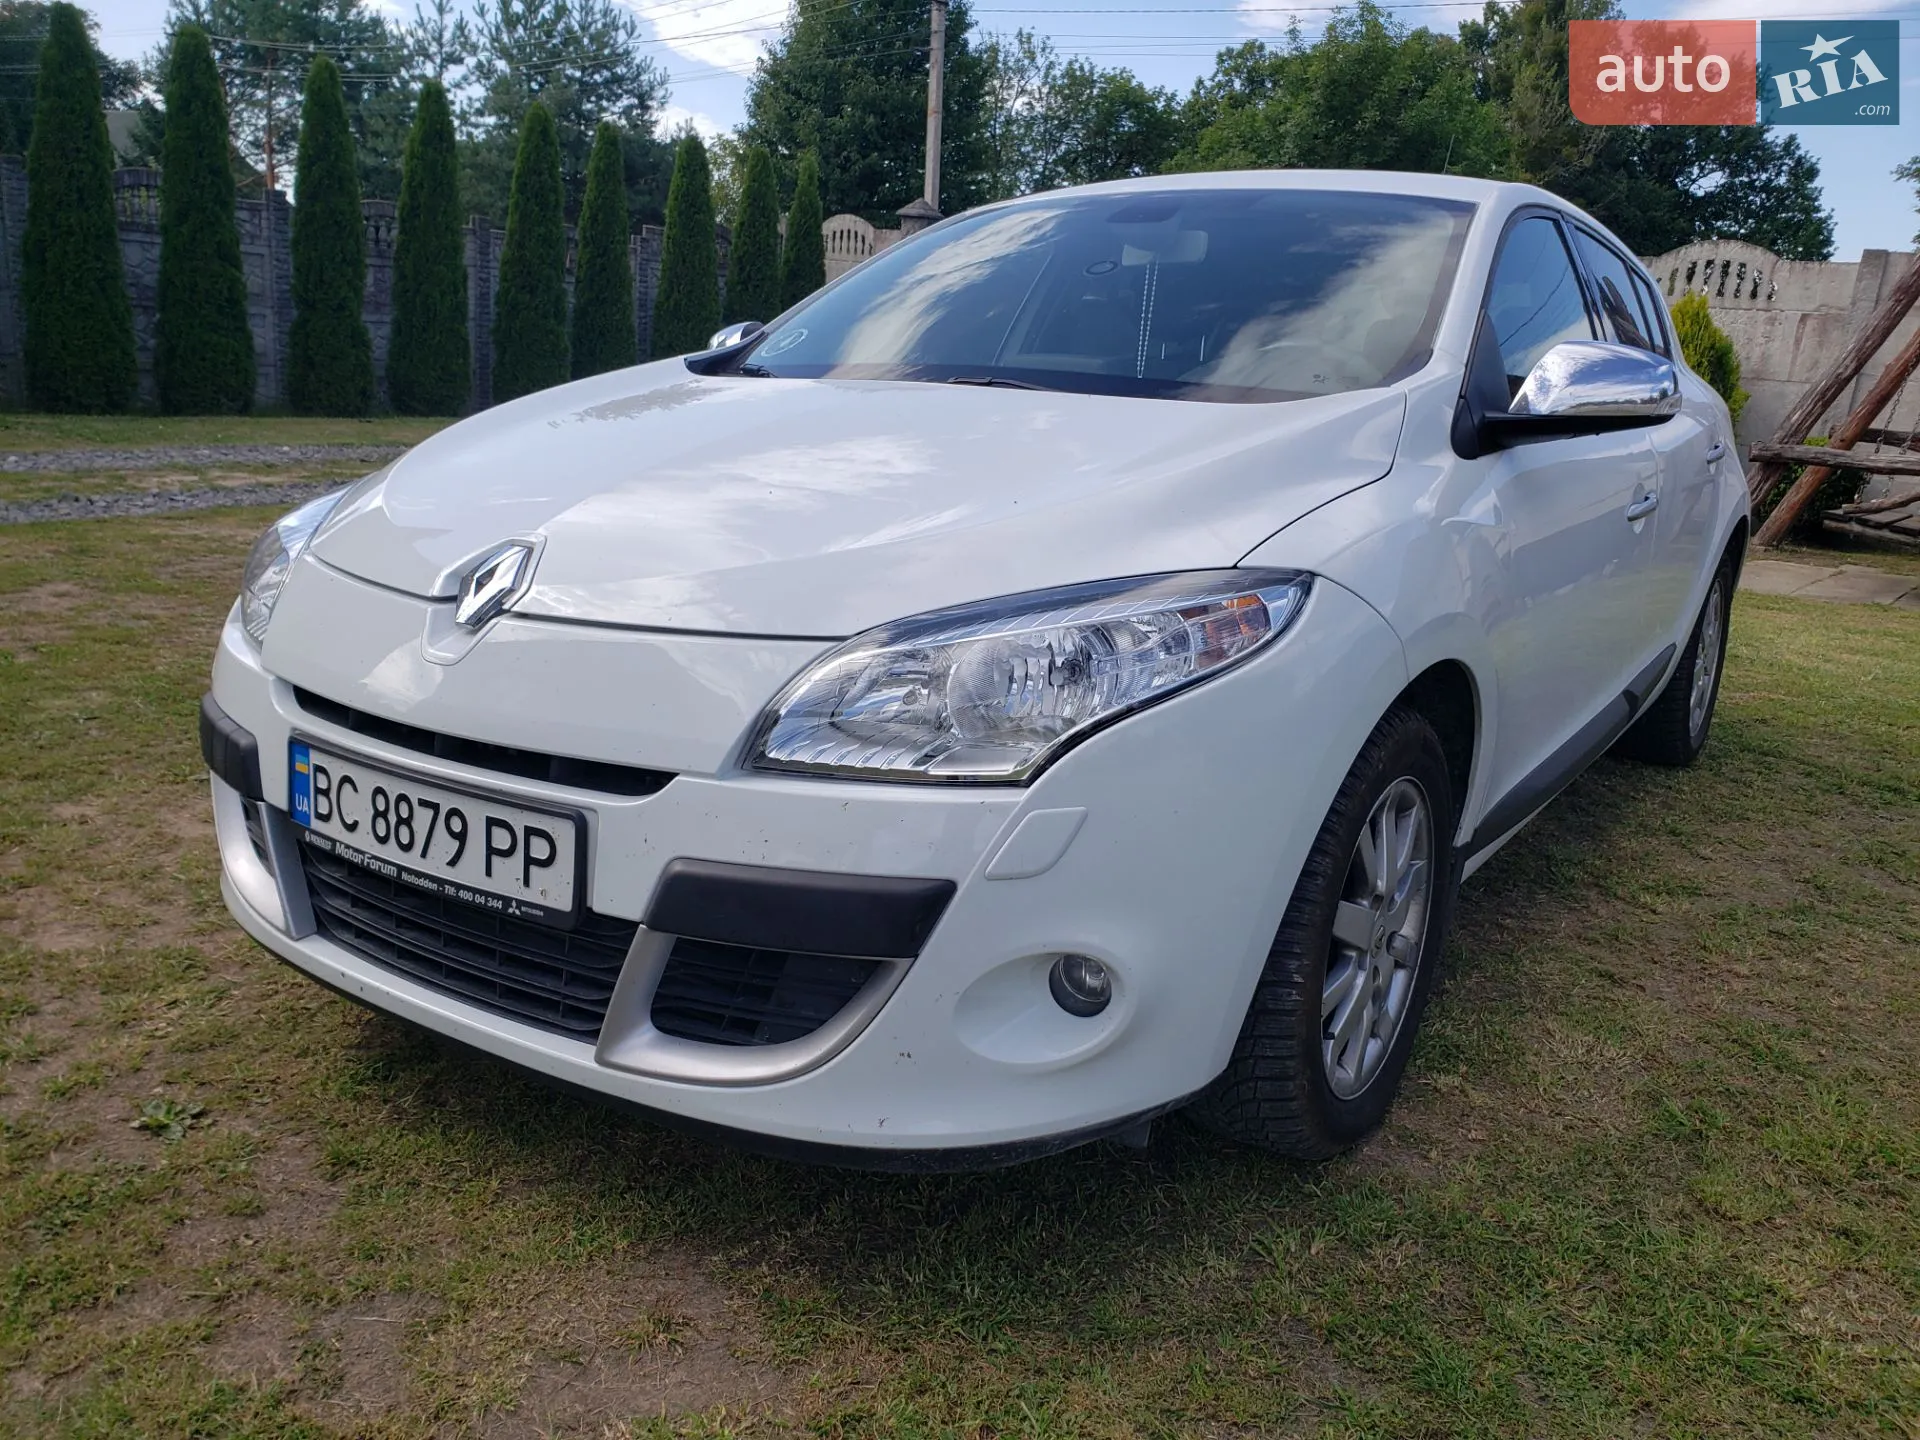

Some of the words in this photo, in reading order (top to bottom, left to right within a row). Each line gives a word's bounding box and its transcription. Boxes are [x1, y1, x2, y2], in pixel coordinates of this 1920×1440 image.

[295, 796, 310, 814] UA
[312, 762, 360, 833] BC
[370, 786, 469, 867] 8879
[485, 815, 557, 888] PP
[401, 871, 438, 891] Notodden
[457, 889, 474, 901] 400
[474, 894, 486, 905] 04
[486, 897, 503, 910] 344
